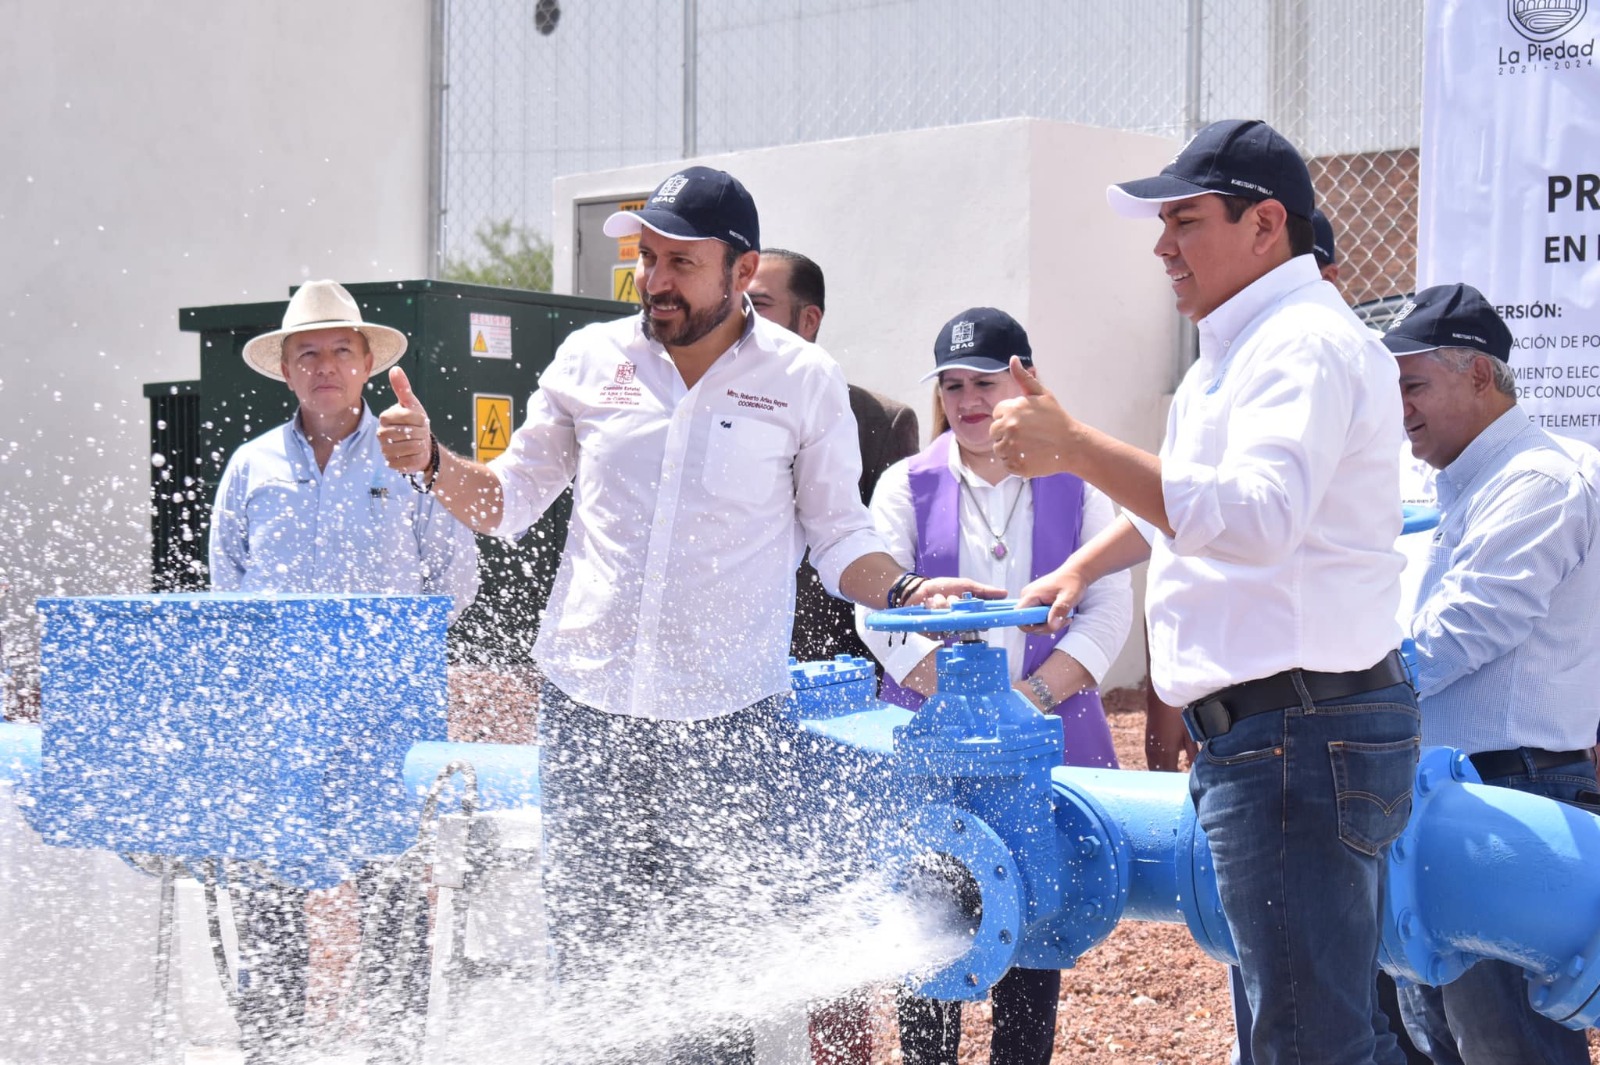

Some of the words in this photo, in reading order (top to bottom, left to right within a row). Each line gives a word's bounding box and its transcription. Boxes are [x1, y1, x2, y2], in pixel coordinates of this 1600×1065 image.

[1498, 46, 1519, 65] La
[1528, 38, 1594, 63] Piedad
[1547, 174, 1600, 213] PR
[1544, 235, 1586, 263] EN
[1493, 301, 1562, 319] ERSIÓN:
[950, 342, 975, 352] CEAC
[1561, 335, 1578, 348] DE
